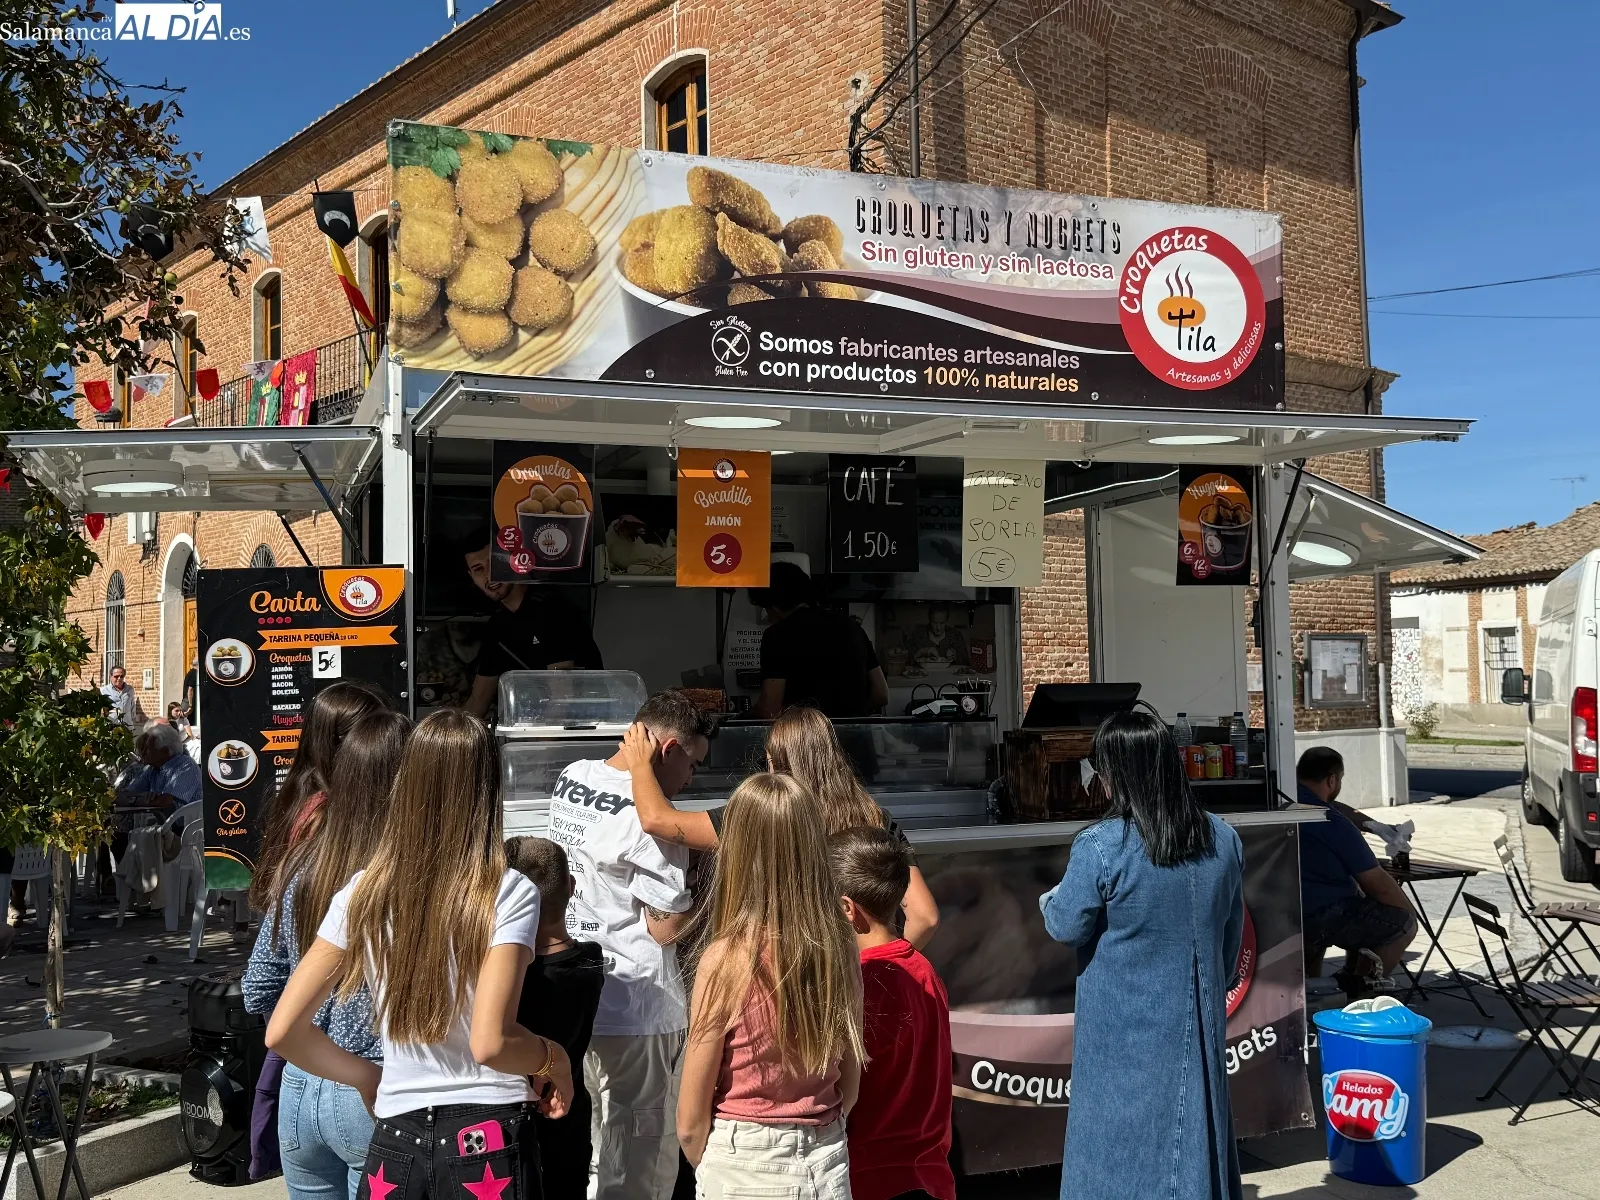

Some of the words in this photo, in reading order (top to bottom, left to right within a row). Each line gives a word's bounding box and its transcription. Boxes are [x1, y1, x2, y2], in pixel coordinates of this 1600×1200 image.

[855, 195, 990, 244] CROQUETAS
[1003, 209, 1013, 246] Y
[1026, 212, 1121, 255] NUGGETS
[861, 240, 897, 263] Sin
[904, 246, 974, 271] gluten
[980, 254, 993, 275] y
[999, 253, 1031, 273] sin
[1036, 255, 1115, 279] lactosa
[1120, 230, 1208, 314] Croquetas
[709, 319, 725, 331] Sin
[726, 315, 752, 333] Gluten
[759, 331, 834, 355] Somos
[838, 336, 959, 362] fabricantes
[963, 346, 1081, 369] artesanales
[1166, 367, 1222, 384] Artesanas
[1224, 367, 1232, 380] y
[1233, 321, 1262, 370] deliciosas
[714, 365, 734, 377] Gluten
[735, 366, 749, 377] Free
[758, 360, 800, 377] con
[806, 362, 917, 384] productos
[923, 366, 980, 387] 100%
[984, 370, 1080, 393] naturales
[507, 460, 572, 484] Croquetas
[843, 459, 906, 506] CAFÉ
[693, 484, 753, 508] Bocadillo
[1186, 475, 1229, 500] Nuggets
[992, 494, 1021, 512] DE
[704, 513, 742, 527] JAMÓN
[967, 517, 1037, 542] SORIA
[709, 543, 733, 566] 5€
[842, 530, 898, 560] 1,50€
[973, 551, 1010, 578] 5€
[249, 590, 322, 614] Carta
[268, 634, 302, 643] TARRINA
[304, 631, 340, 642] PEQUEÑA
[269, 652, 312, 666] Croquetas
[271, 665, 293, 673] JAMÓN
[317, 650, 337, 672] 5€
[272, 703, 301, 711] BACALAO
[272, 713, 304, 726] Nuggets
[271, 734, 300, 744] TARRIN
[553, 774, 636, 816] orever
[1226, 1025, 1278, 1075] gets
[1341, 1080, 1384, 1095] Helados
[182, 1100, 211, 1119] XBOOM
[1322, 1076, 1408, 1137] Camy
